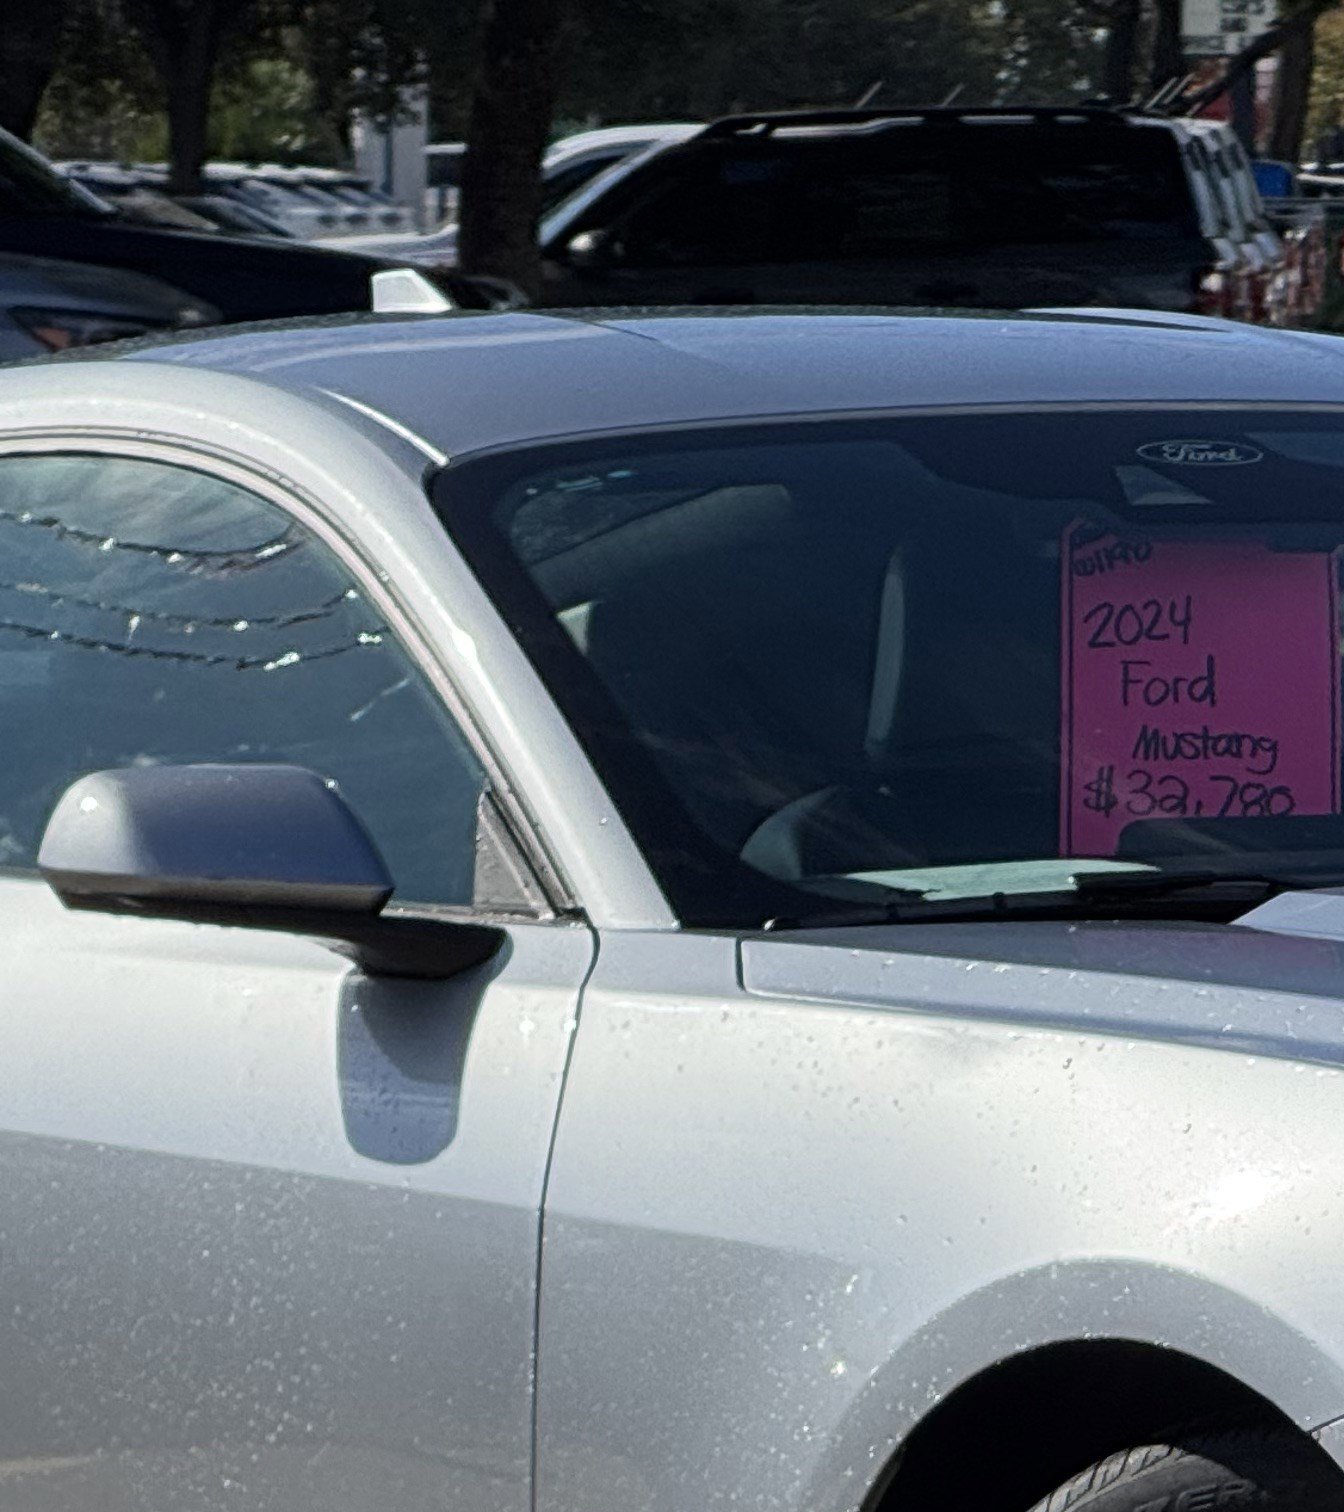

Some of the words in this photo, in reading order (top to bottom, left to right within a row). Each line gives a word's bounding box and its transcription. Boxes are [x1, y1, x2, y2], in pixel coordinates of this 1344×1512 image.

[1083, 595, 1193, 649] 2024
[1120, 654, 1217, 707] Ford
[1132, 724, 1279, 775] Mustang
[1083, 765, 1296, 818] $32,780
